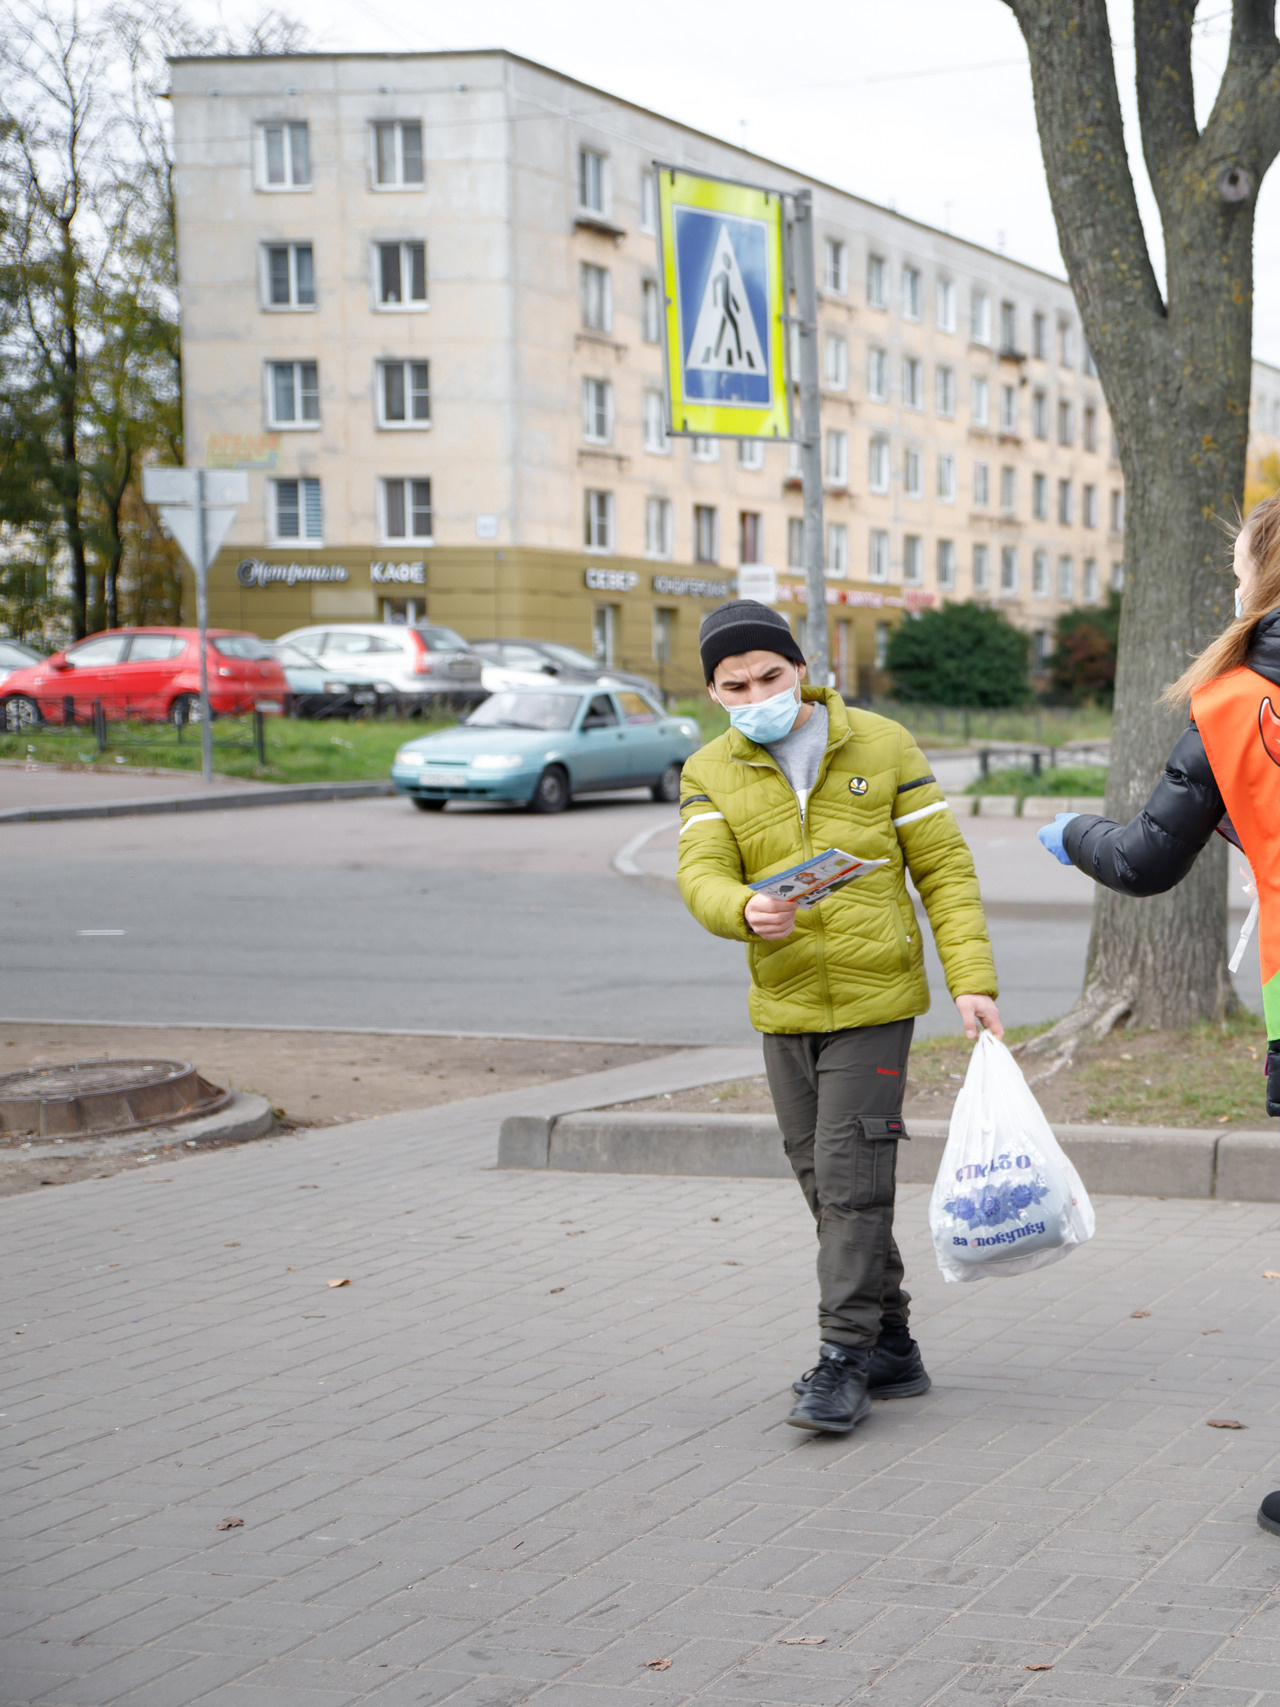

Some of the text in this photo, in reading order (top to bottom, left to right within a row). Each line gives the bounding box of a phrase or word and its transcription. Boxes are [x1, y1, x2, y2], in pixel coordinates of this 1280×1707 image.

[370, 561, 427, 584] КАФЕ
[585, 567, 639, 592] СЕВЕР
[952, 1220, 1046, 1248] за покупку
